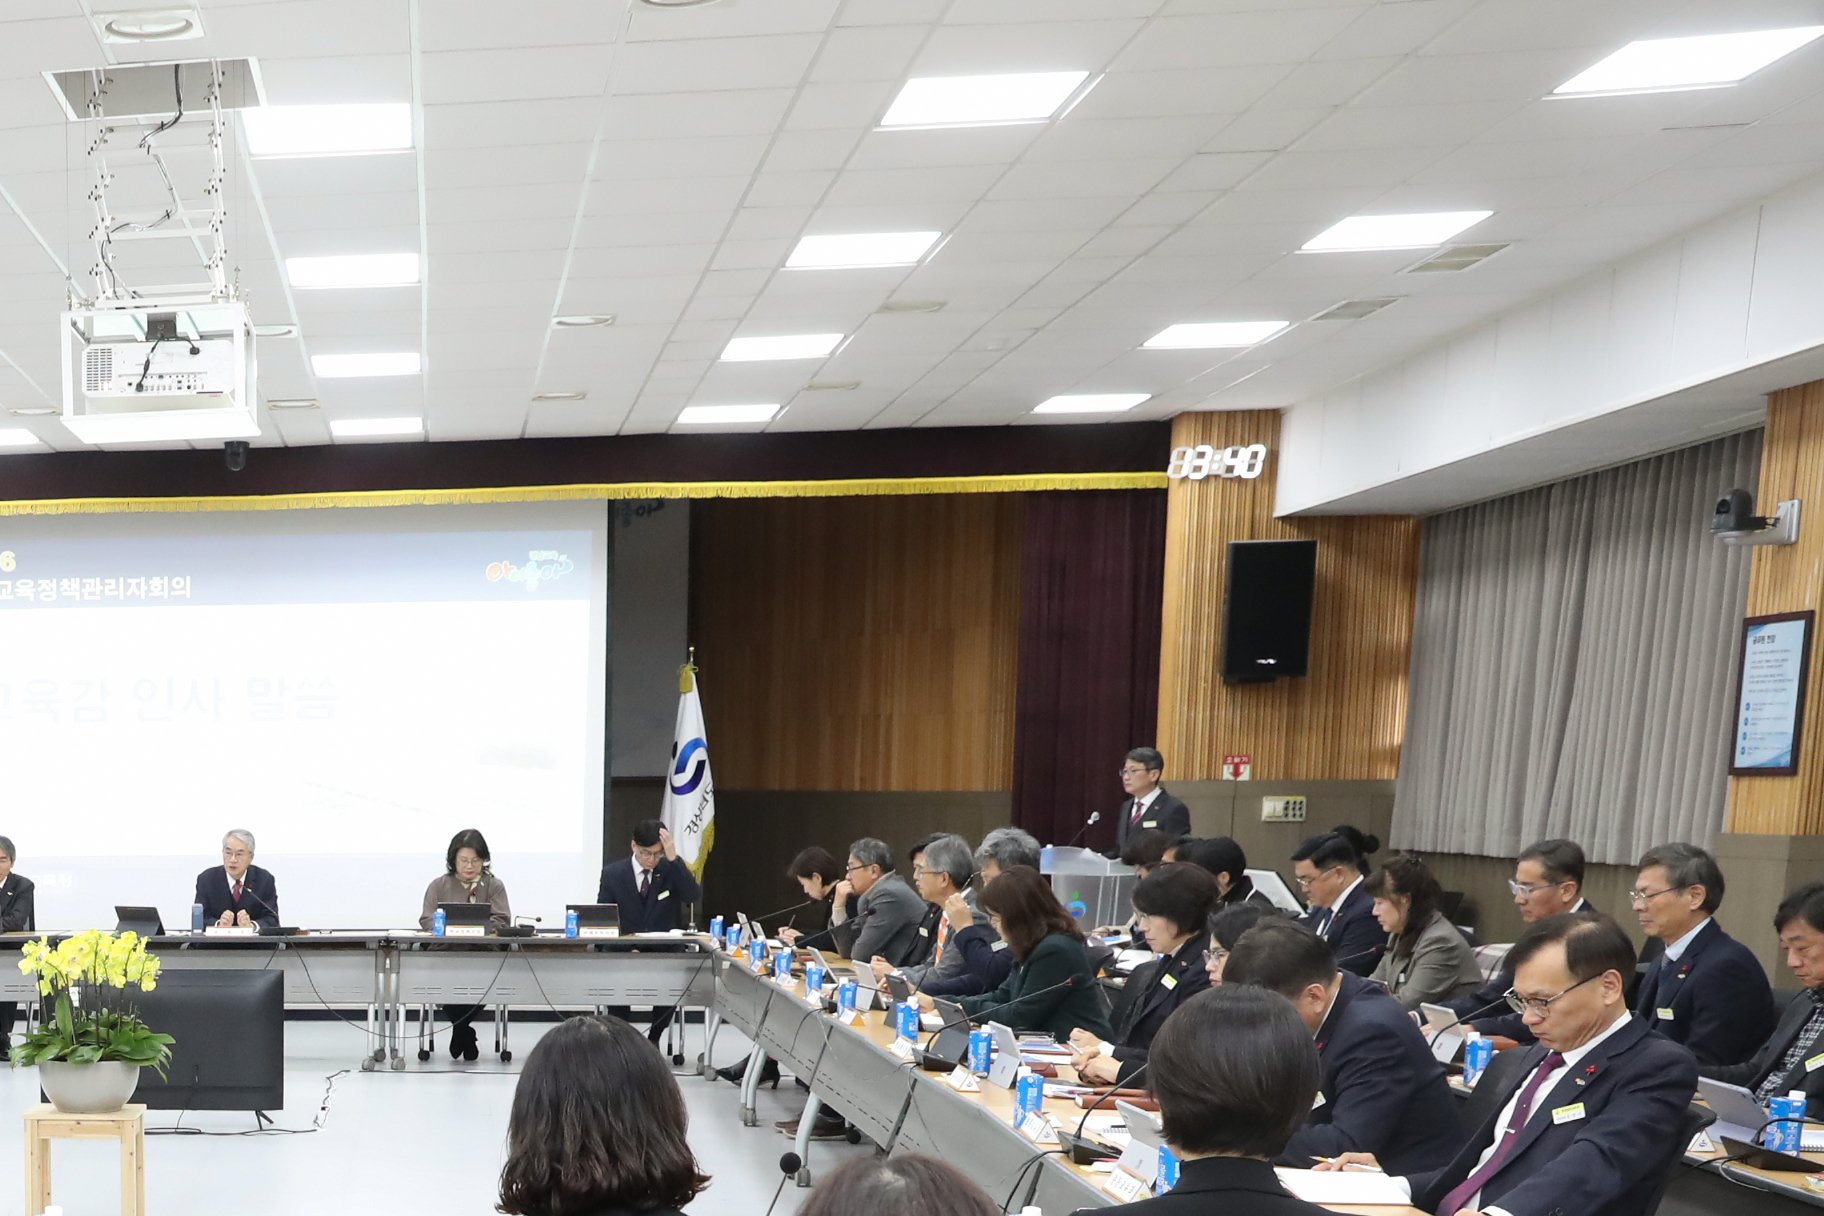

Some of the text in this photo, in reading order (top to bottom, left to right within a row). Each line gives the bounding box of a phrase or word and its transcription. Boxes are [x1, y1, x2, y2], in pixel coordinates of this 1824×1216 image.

[1180, 443, 1267, 480] 13:40
[132, 675, 227, 722] 인사
[244, 674, 339, 722] 말씀
